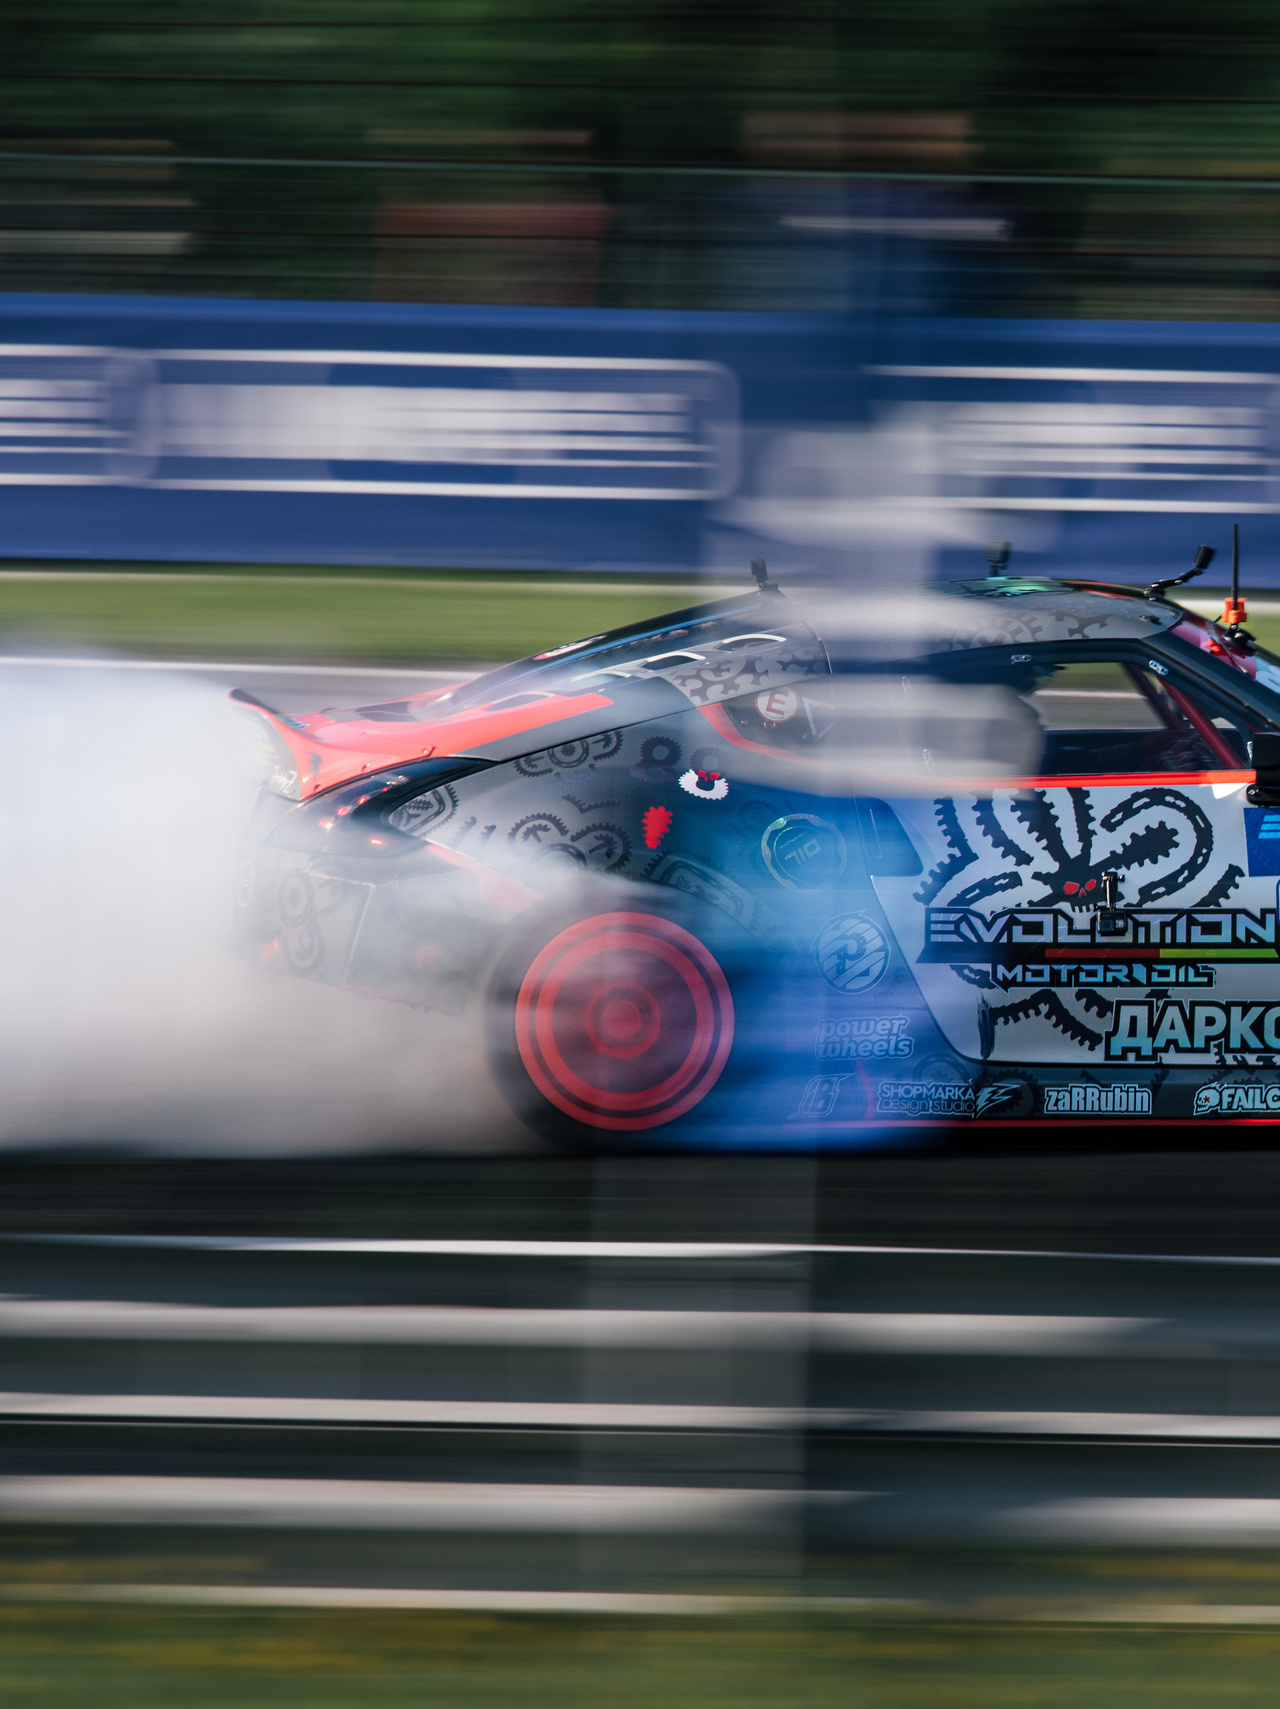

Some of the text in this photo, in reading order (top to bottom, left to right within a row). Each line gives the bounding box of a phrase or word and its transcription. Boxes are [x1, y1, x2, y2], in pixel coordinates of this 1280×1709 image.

[1001, 964, 1213, 983] MOTOR OIL
[818, 1017, 907, 1038] power
[818, 1036, 911, 1058] wheels
[881, 1084, 975, 1100] SHOPMARKA
[1048, 1086, 1150, 1112] zaRRubin
[882, 1098, 976, 1114] design studio
